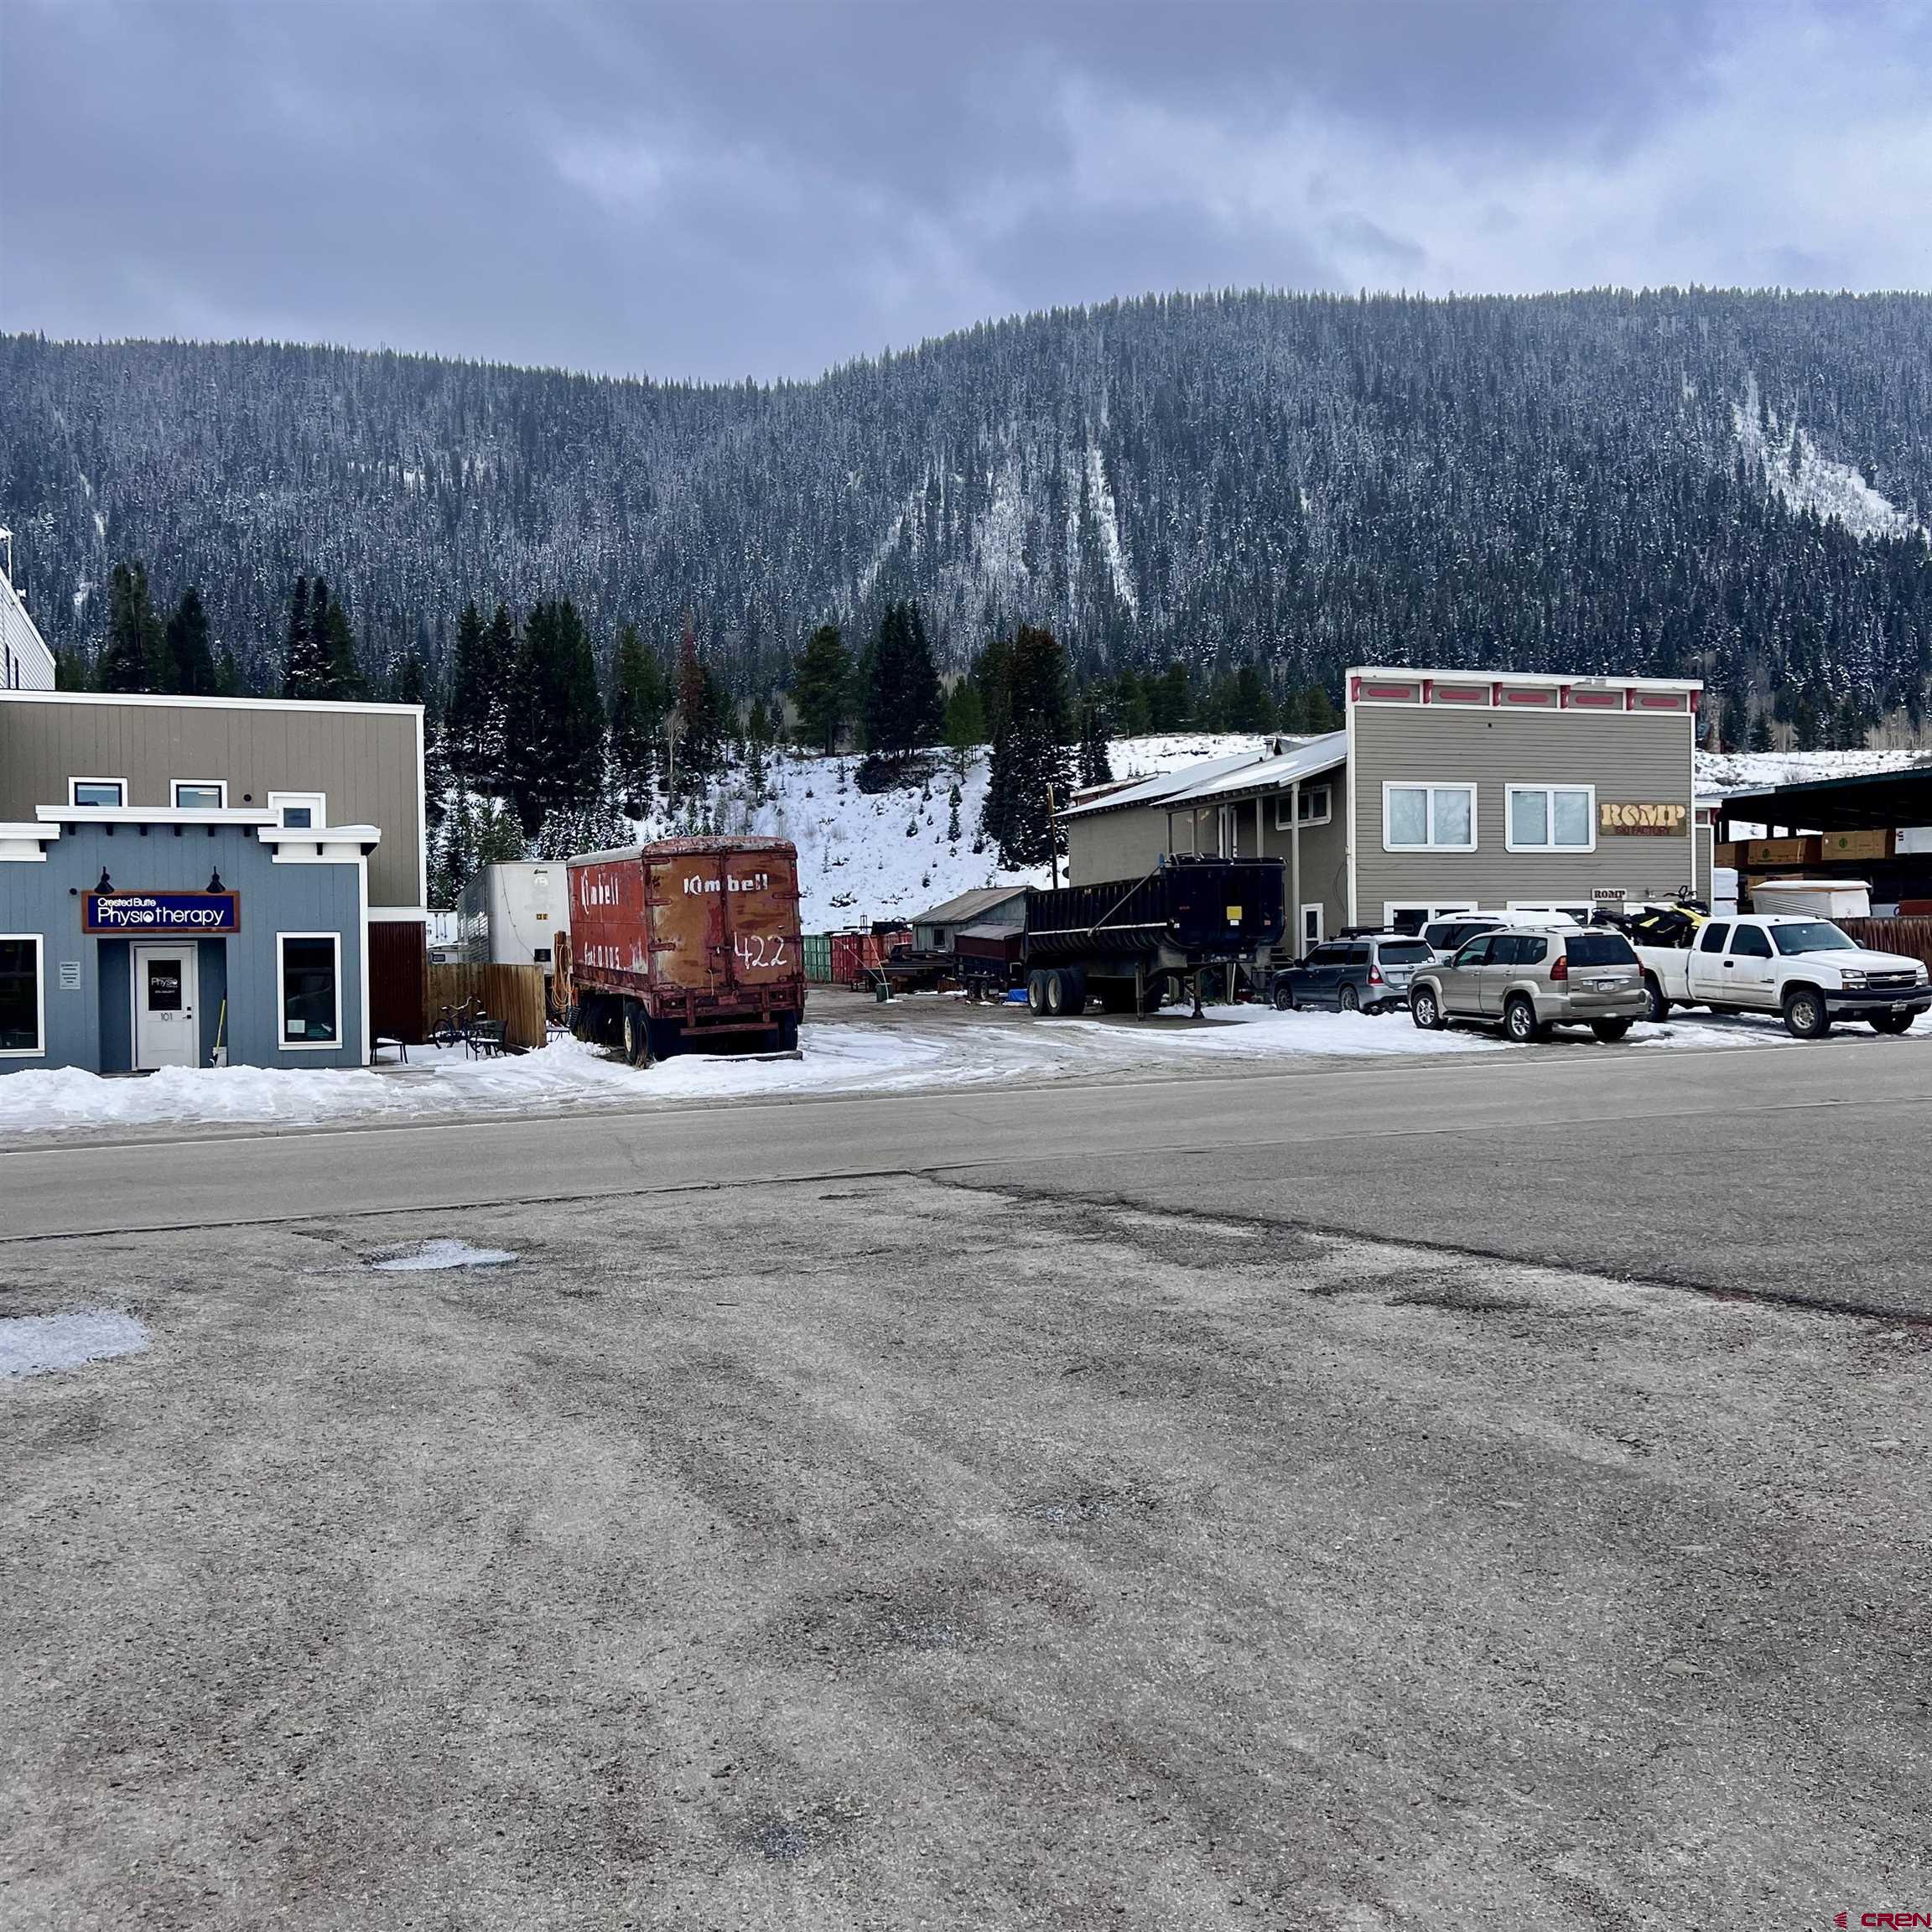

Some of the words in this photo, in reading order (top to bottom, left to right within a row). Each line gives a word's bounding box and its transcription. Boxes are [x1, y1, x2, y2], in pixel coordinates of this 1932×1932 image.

[1601, 804, 1685, 826] ROMP
[97, 897, 132, 906] Crested
[1594, 890, 1625, 899] ROMP
[97, 906, 225, 926] Physiotherapy
[735, 932, 787, 970] 422
